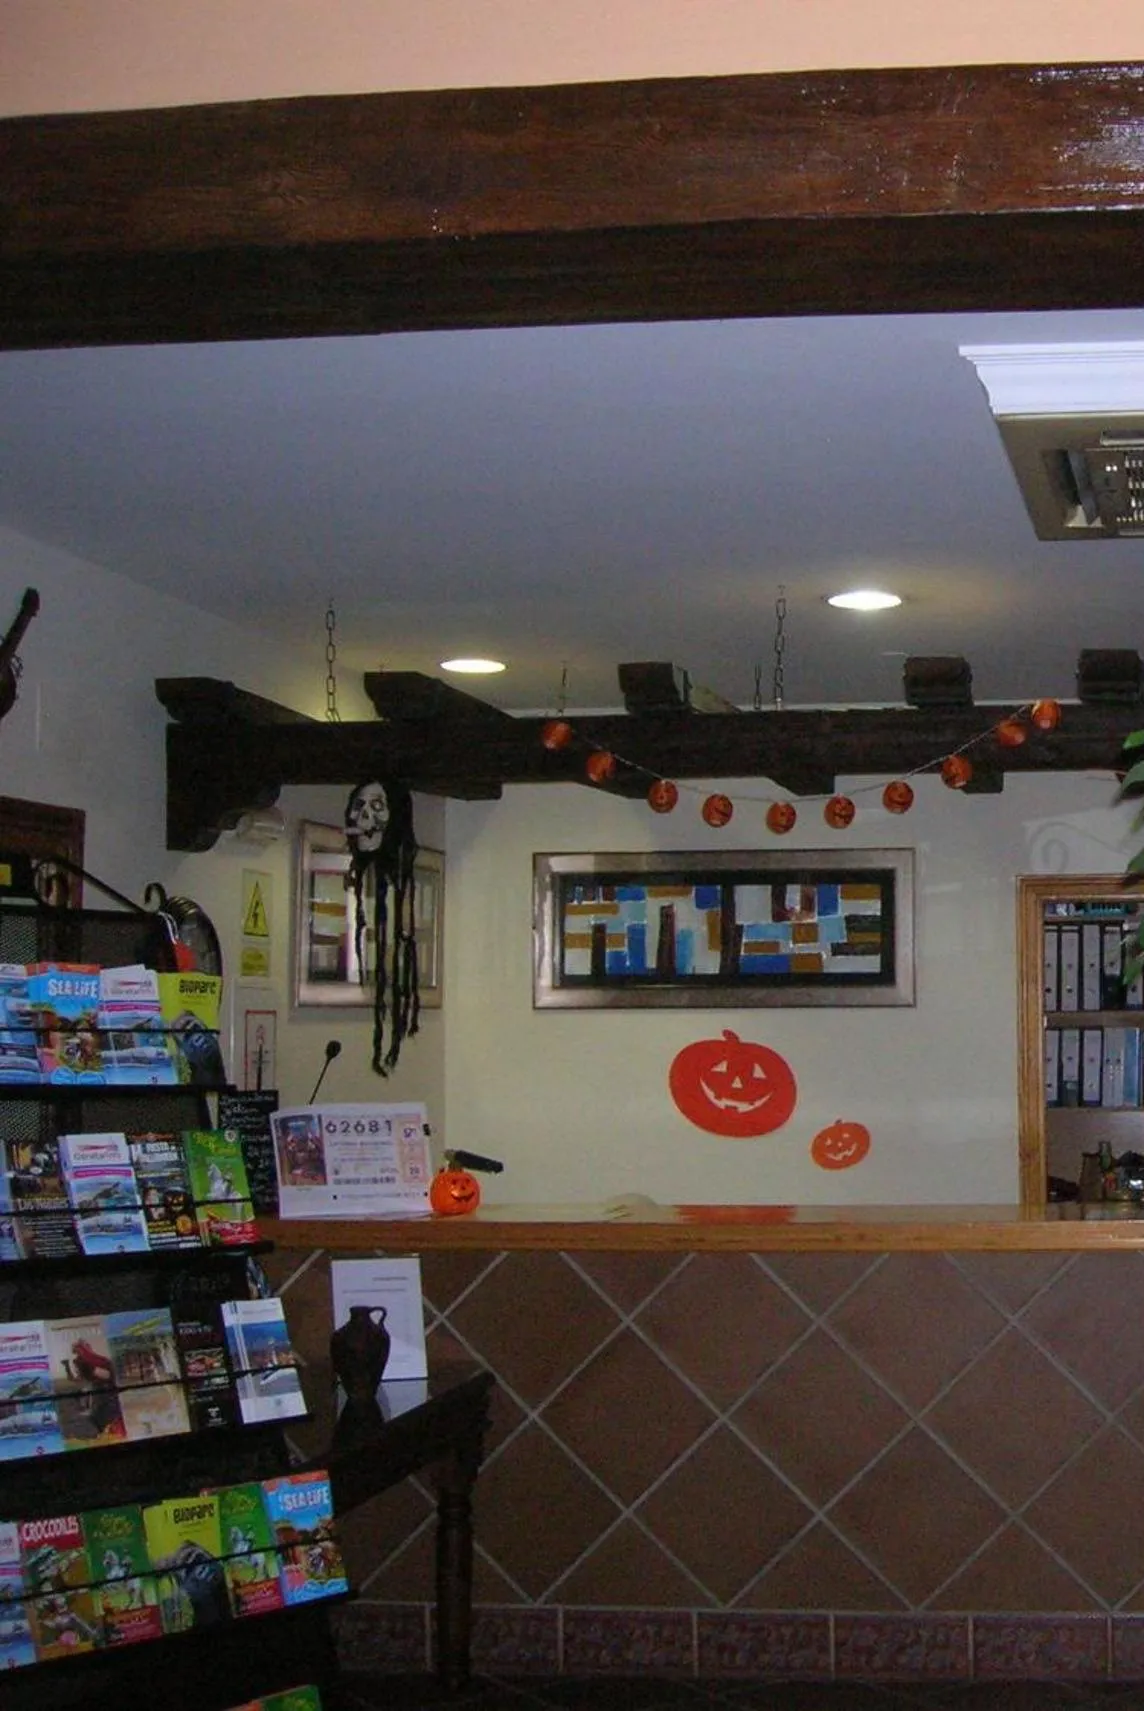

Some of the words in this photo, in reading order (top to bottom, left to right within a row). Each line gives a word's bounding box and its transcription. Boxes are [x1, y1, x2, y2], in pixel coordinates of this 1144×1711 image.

[48, 978, 72, 997] SEA
[74, 980, 98, 999] LIFE
[324, 1119, 393, 1134] 62681
